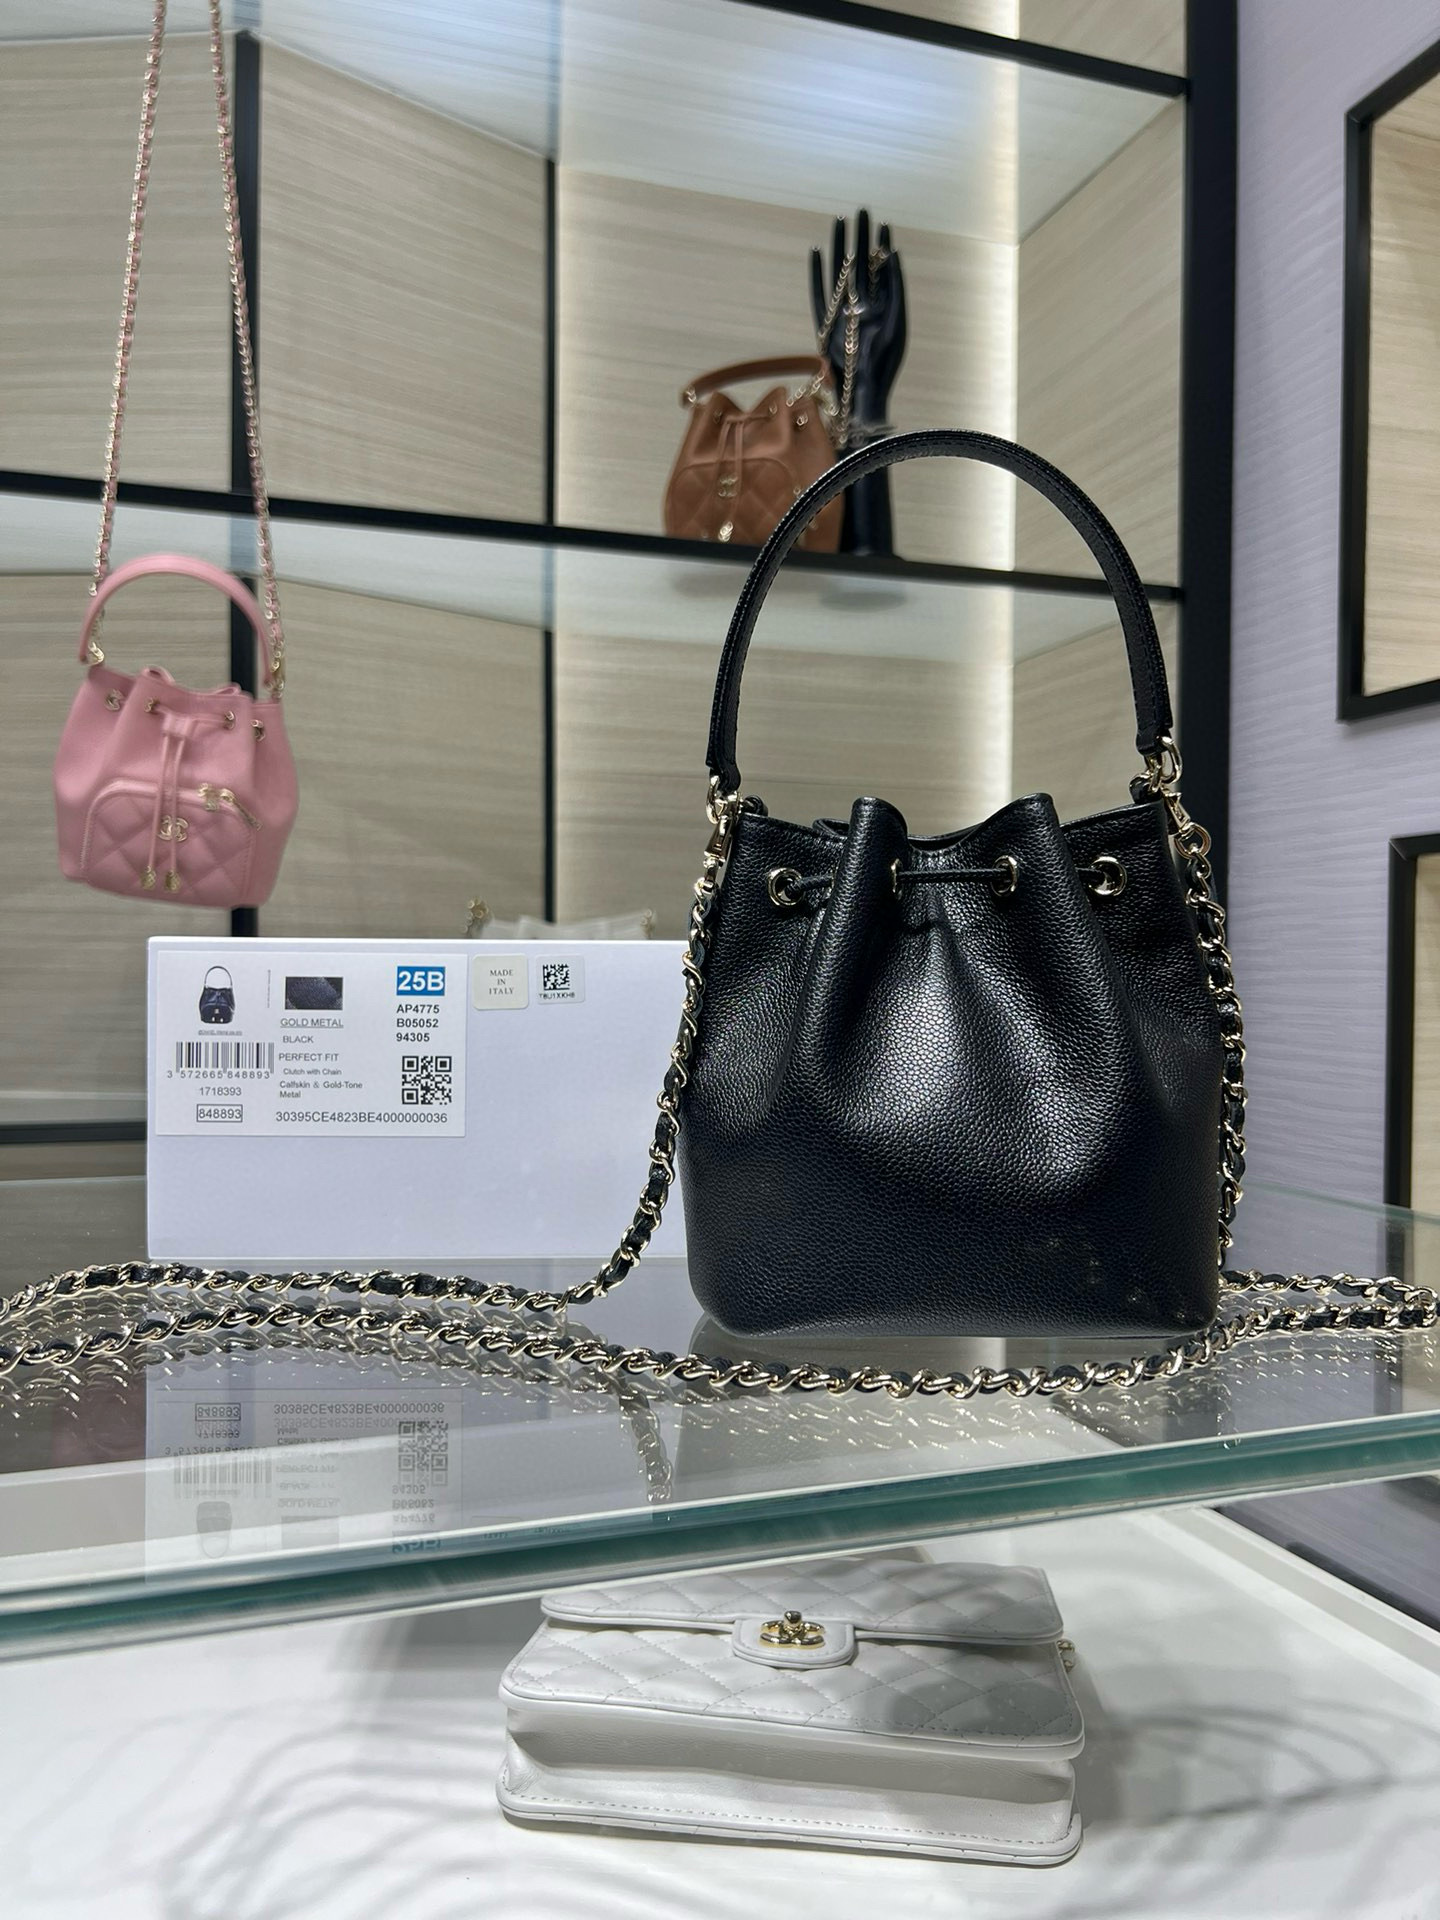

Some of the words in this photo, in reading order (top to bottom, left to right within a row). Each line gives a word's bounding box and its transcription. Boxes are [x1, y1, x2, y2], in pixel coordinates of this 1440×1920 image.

[490, 969, 514, 977] MADE
[398, 971, 444, 991] 25B
[489, 987, 515, 995] ITALY
[397, 1004, 440, 1014] AP4775
[280, 1018, 309, 1027] GOLD
[311, 1018, 344, 1027] METAL
[396, 1019, 439, 1028] B05052
[282, 1036, 314, 1044] BLACK
[396, 1033, 430, 1042] 94305
[278, 1053, 323, 1062] PERFECT
[325, 1053, 340, 1061] FIT
[167, 1071, 173, 1079] 3
[180, 1071, 223, 1079] 572665
[227, 1071, 270, 1079] 848893
[283, 1068, 306, 1076] Clutch
[280, 1081, 310, 1089] Calfskin
[313, 1081, 320, 1089] &
[323, 1081, 363, 1089] Gold-Tone
[199, 1087, 242, 1096] 1718393
[198, 1109, 242, 1119] 848893
[275, 1111, 448, 1123] 30395CE4823BE4000000036
